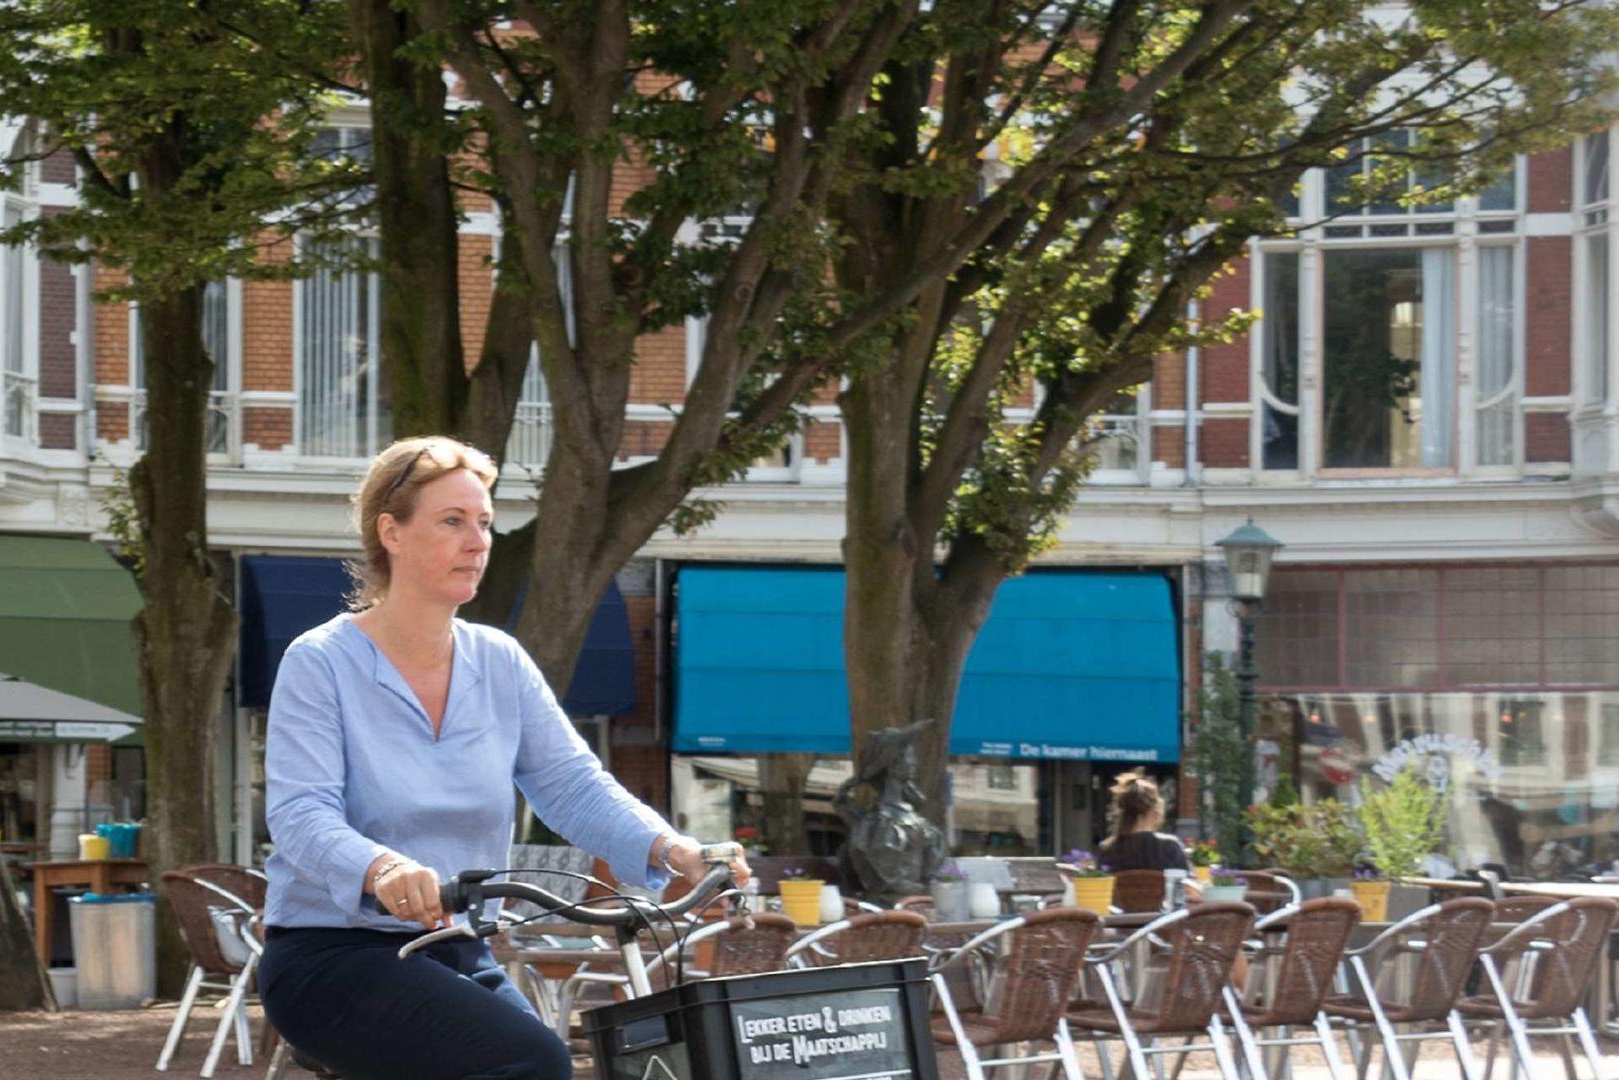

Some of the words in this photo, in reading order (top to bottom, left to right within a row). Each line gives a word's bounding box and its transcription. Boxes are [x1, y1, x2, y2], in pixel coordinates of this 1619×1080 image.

[737, 1015, 787, 1043] LEKKER
[787, 1012, 822, 1033] ETEN
[773, 1043, 792, 1060] DE
